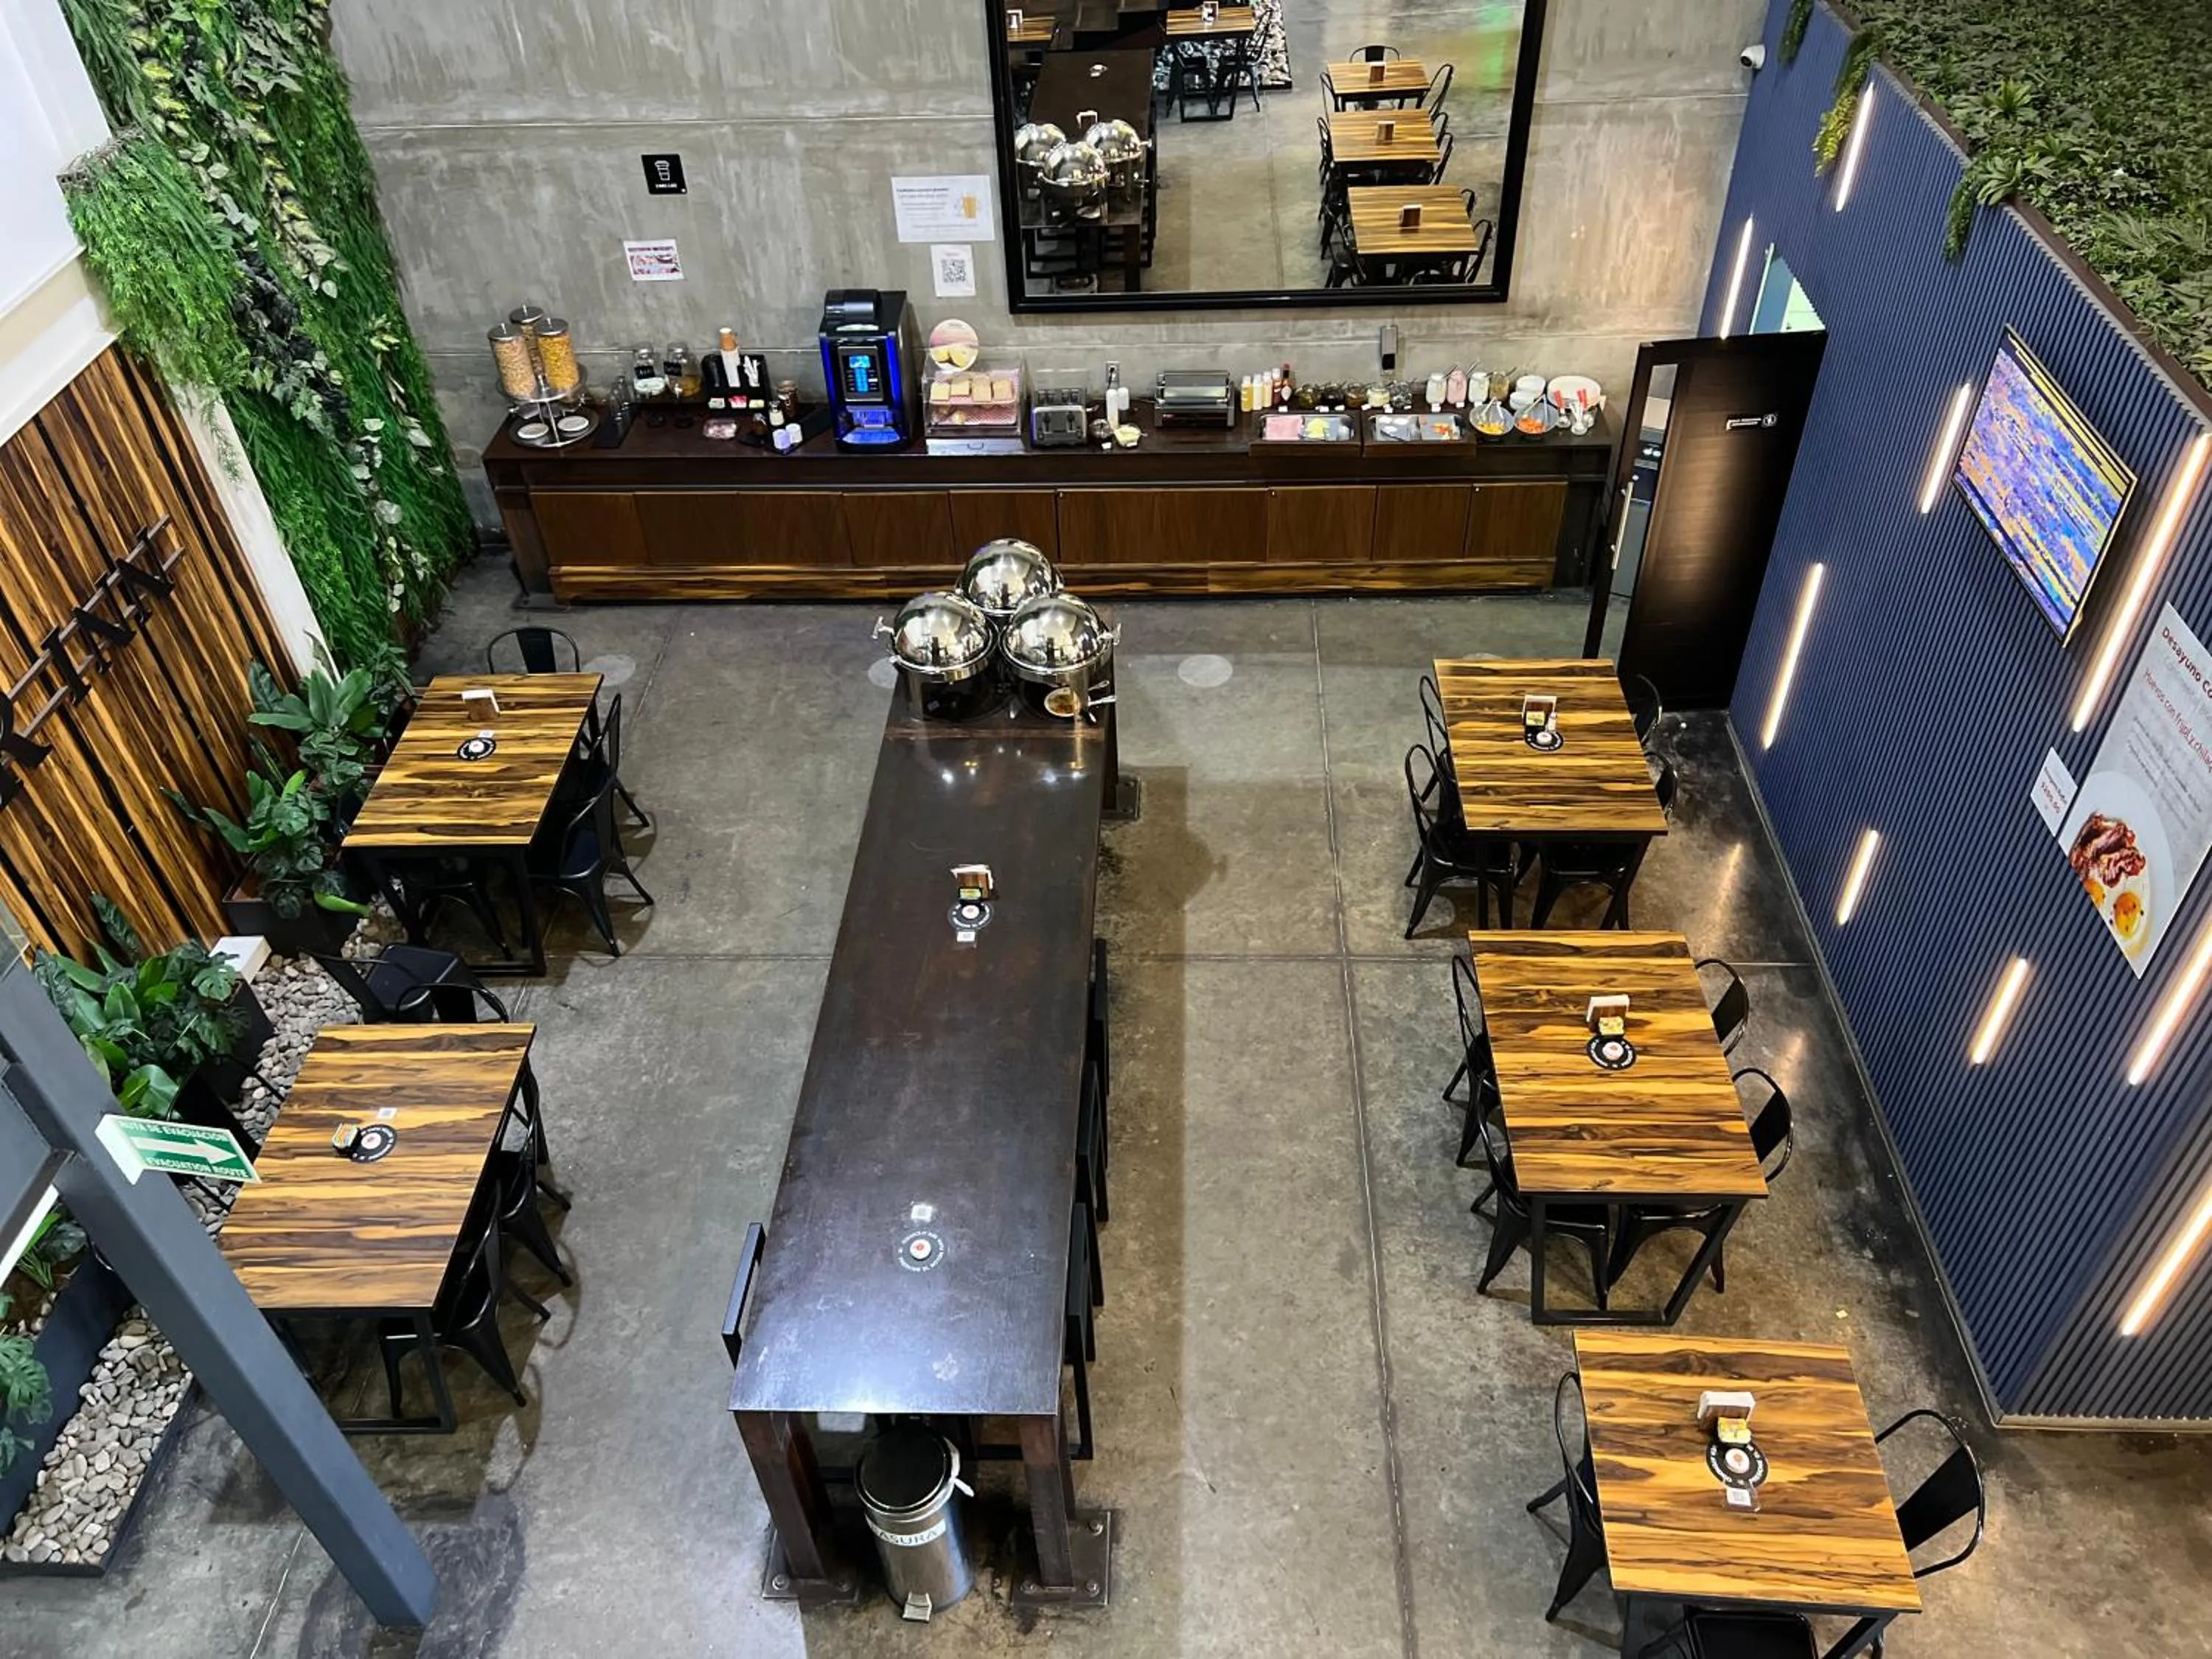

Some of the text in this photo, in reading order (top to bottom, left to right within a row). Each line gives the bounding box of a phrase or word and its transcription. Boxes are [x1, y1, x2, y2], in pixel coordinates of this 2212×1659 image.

[41, 526, 175, 706] INN
[2163, 625, 2201, 682] Desayuno
[145, 1157, 249, 1178] EVACUATION ROUTE
[873, 1525, 938, 1545] ASURA
